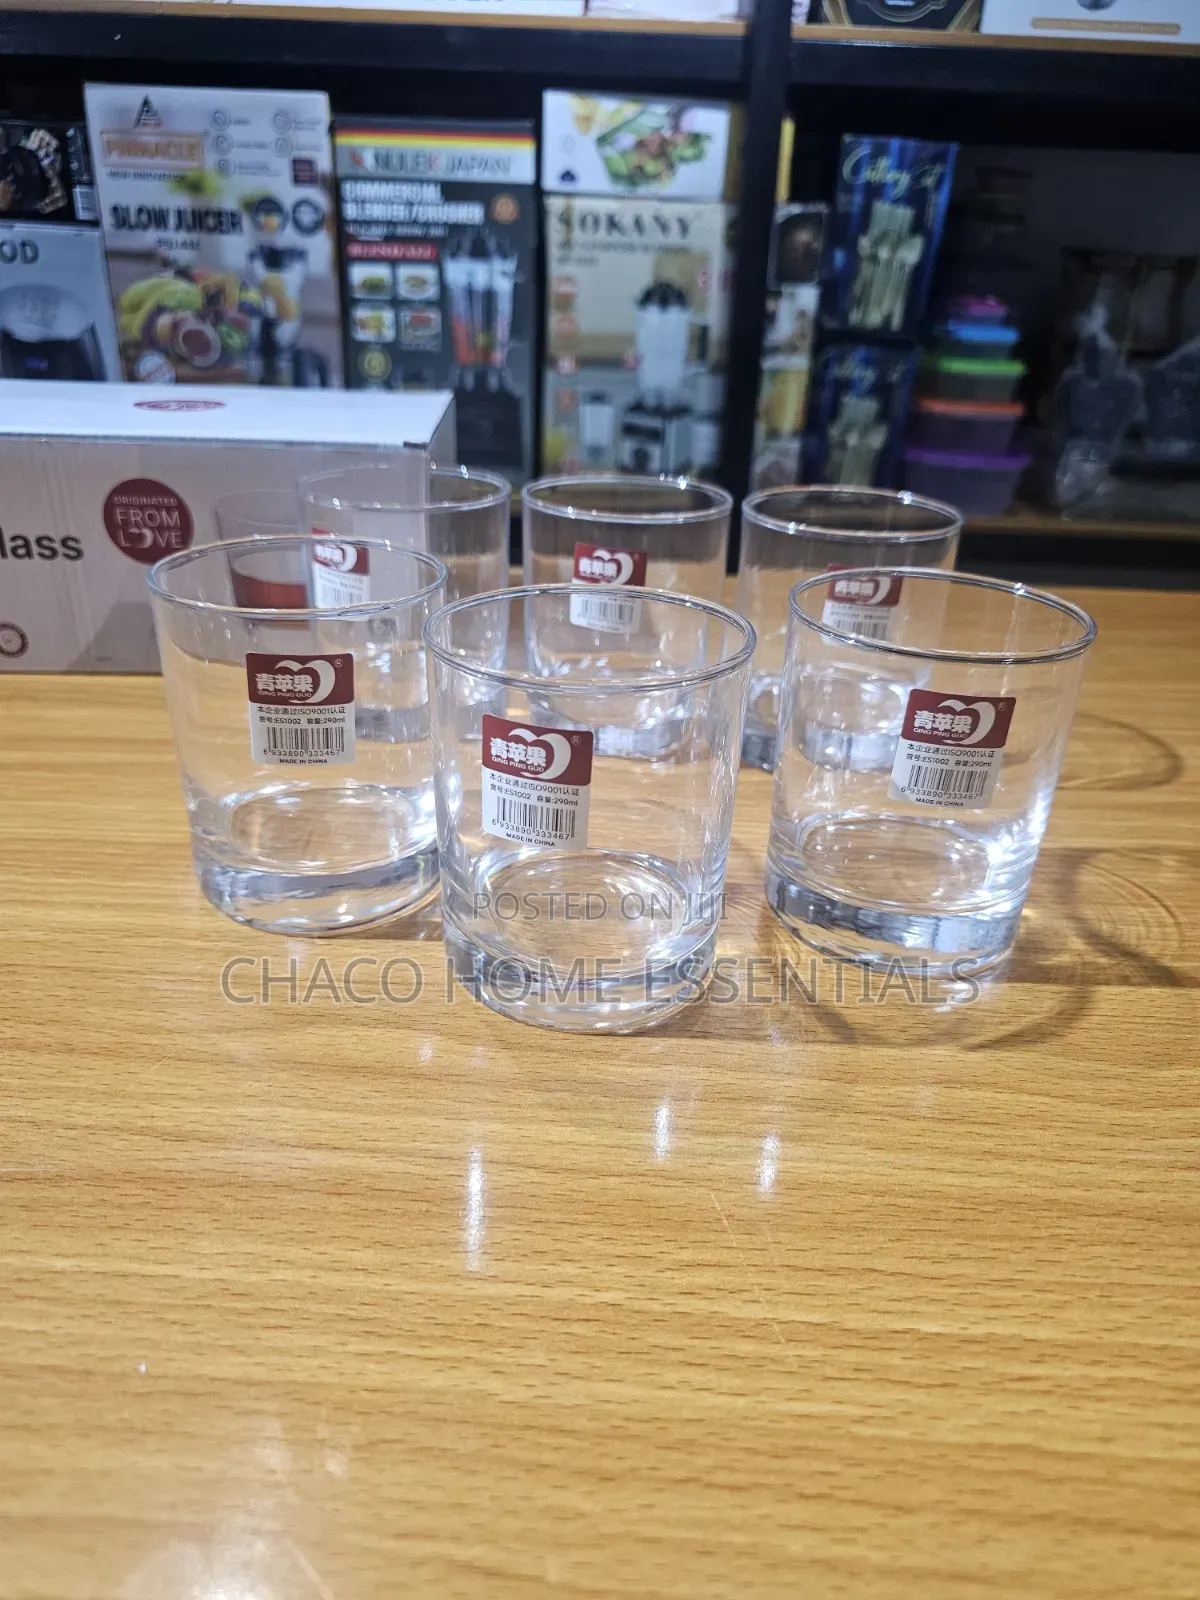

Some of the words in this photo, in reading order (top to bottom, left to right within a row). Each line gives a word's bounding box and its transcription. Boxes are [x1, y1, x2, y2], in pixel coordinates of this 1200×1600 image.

[110, 203, 170, 231] SLOW
[174, 205, 244, 235] JUICER
[114, 495, 179, 507] ORIGINATED
[116, 507, 181, 528] FROM
[256, 673, 314, 692] 青苹果
[914, 710, 973, 734] 青苹果
[913, 727, 932, 735] QING
[933, 730, 950, 738] PING
[490, 737, 547, 767] 青苹果
[491, 756, 509, 765] QING
[509, 760, 526, 770] PING
[528, 764, 545, 773] GUO
[915, 797, 935, 805] MADE
[506, 832, 524, 842] MADE
[534, 838, 555, 847] CHINA
